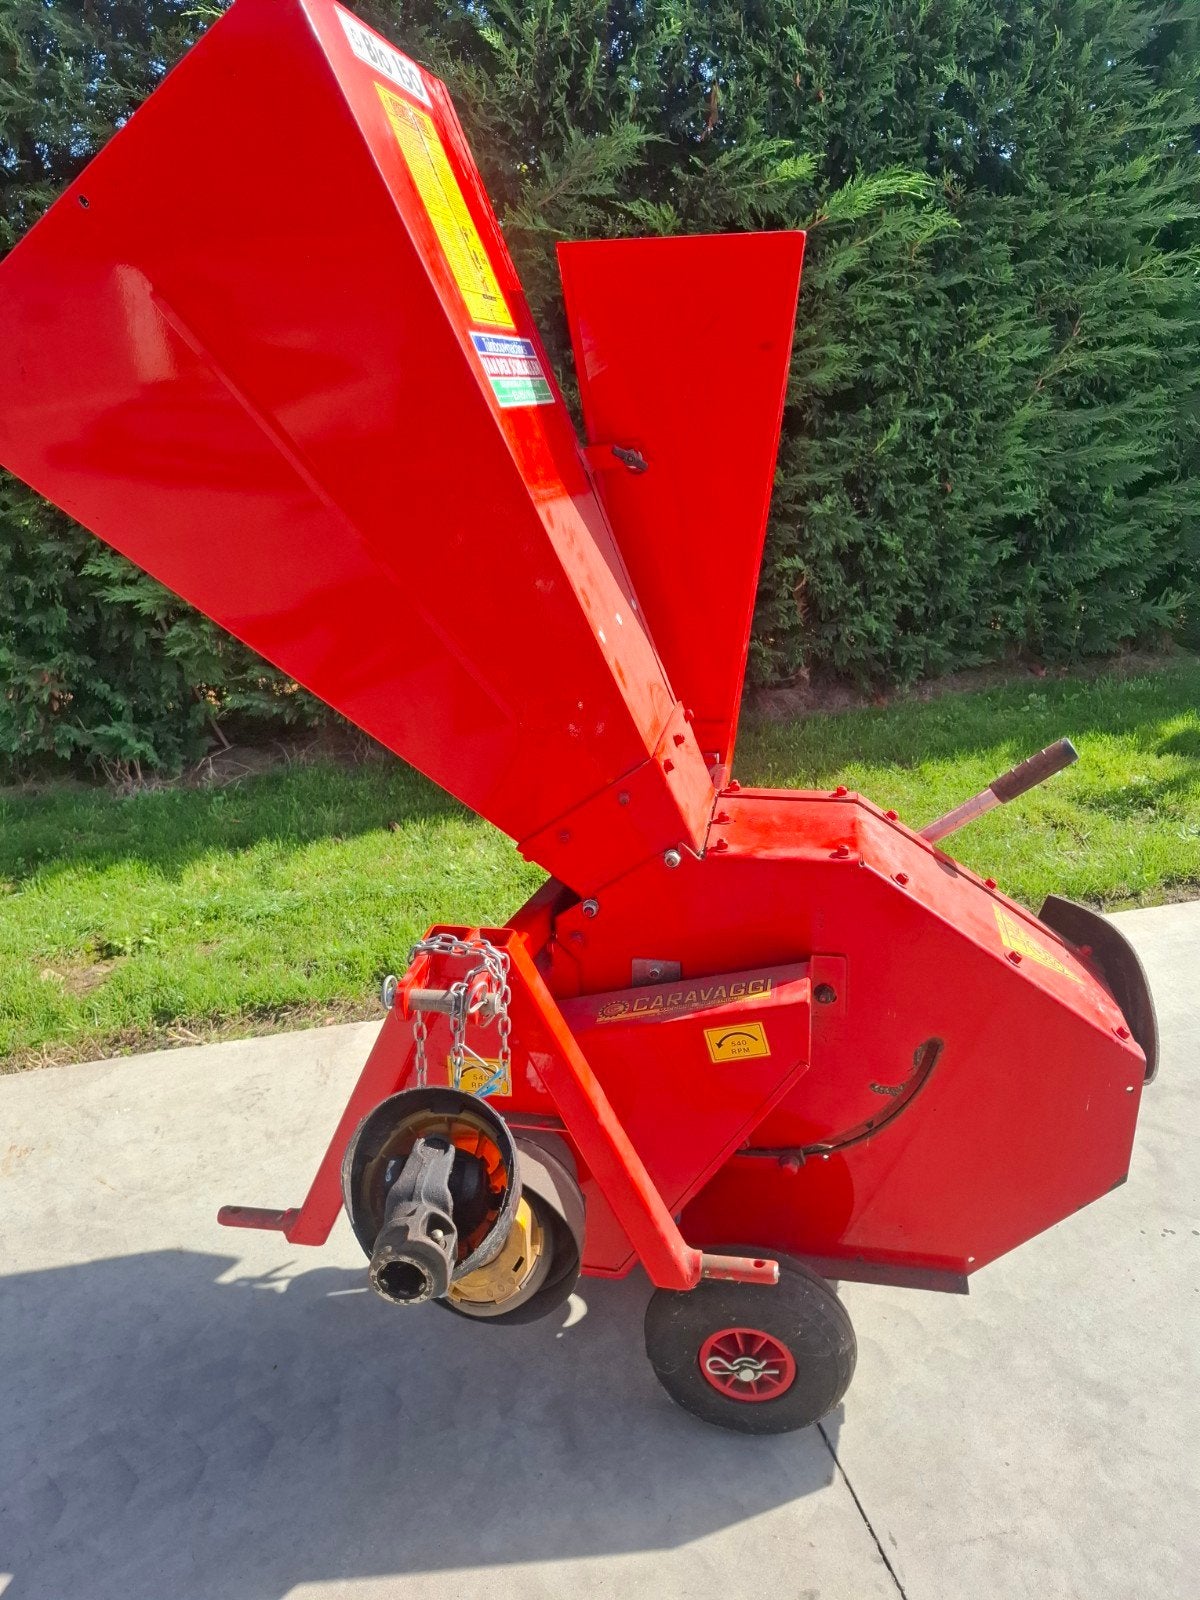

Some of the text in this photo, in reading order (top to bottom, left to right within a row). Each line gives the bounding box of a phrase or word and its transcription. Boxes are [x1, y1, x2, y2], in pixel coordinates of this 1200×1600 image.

[391, 53, 424, 98] 150
[632, 978, 772, 1012] CARAVAGGI
[731, 1039, 747, 1047] 540
[731, 1047, 750, 1055] RPM
